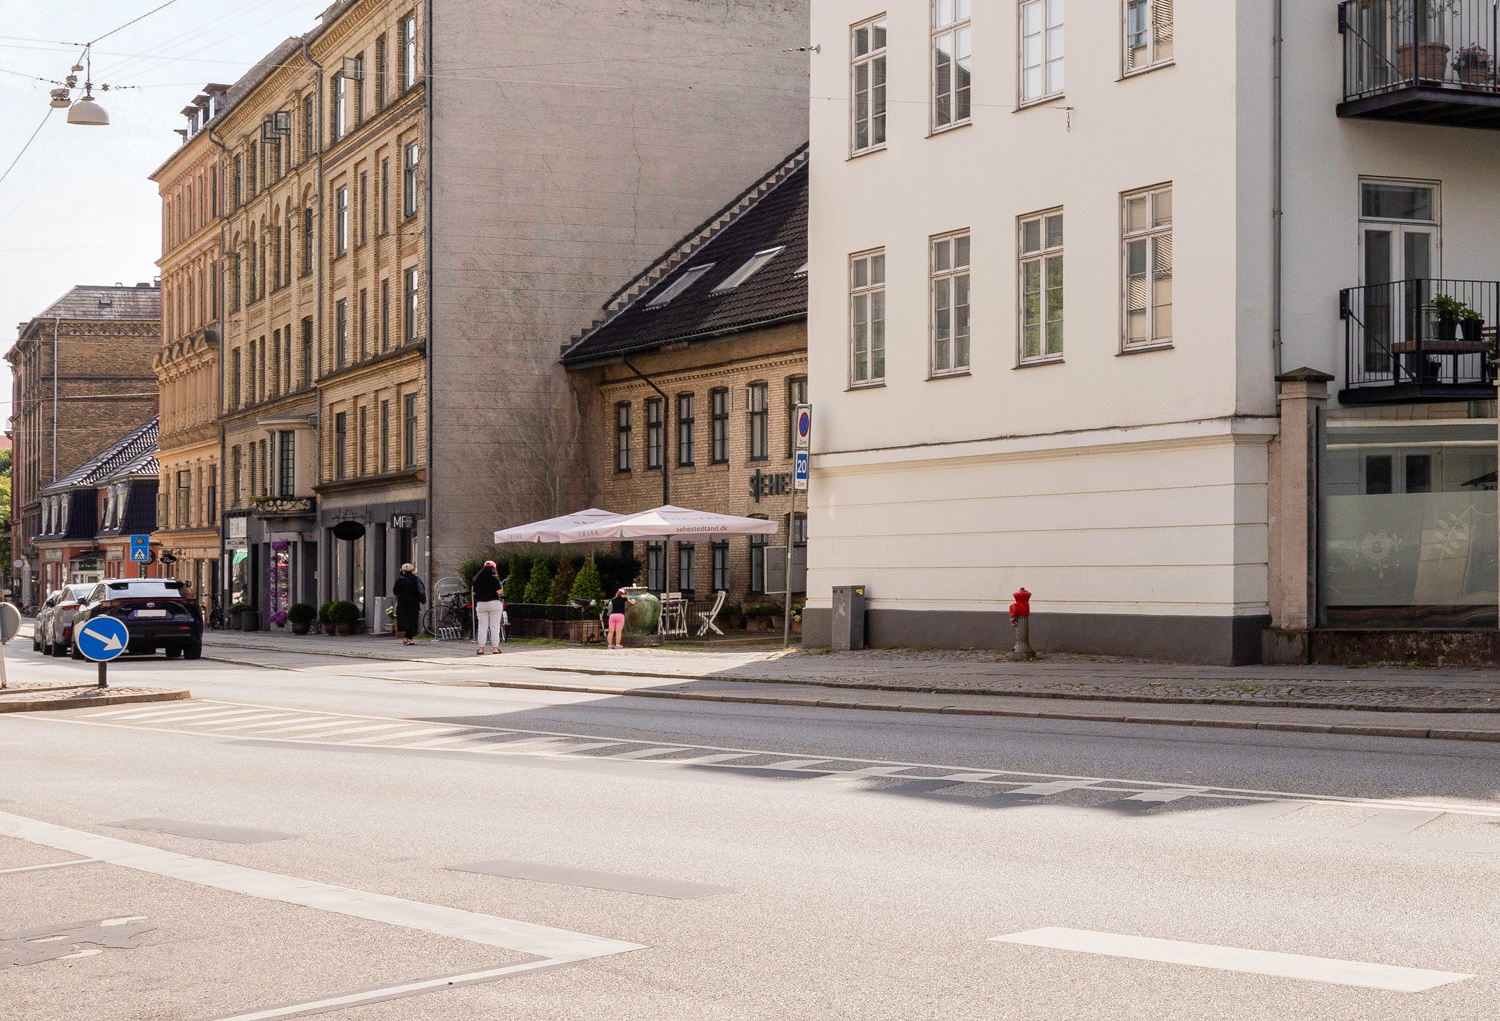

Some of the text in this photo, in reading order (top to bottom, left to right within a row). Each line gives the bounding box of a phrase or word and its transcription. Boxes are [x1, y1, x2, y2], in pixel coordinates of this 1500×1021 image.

[797, 459, 807, 474] 20
[749, 469, 794, 503] SEHE
[676, 525, 728, 533] sehestedtand.dk
